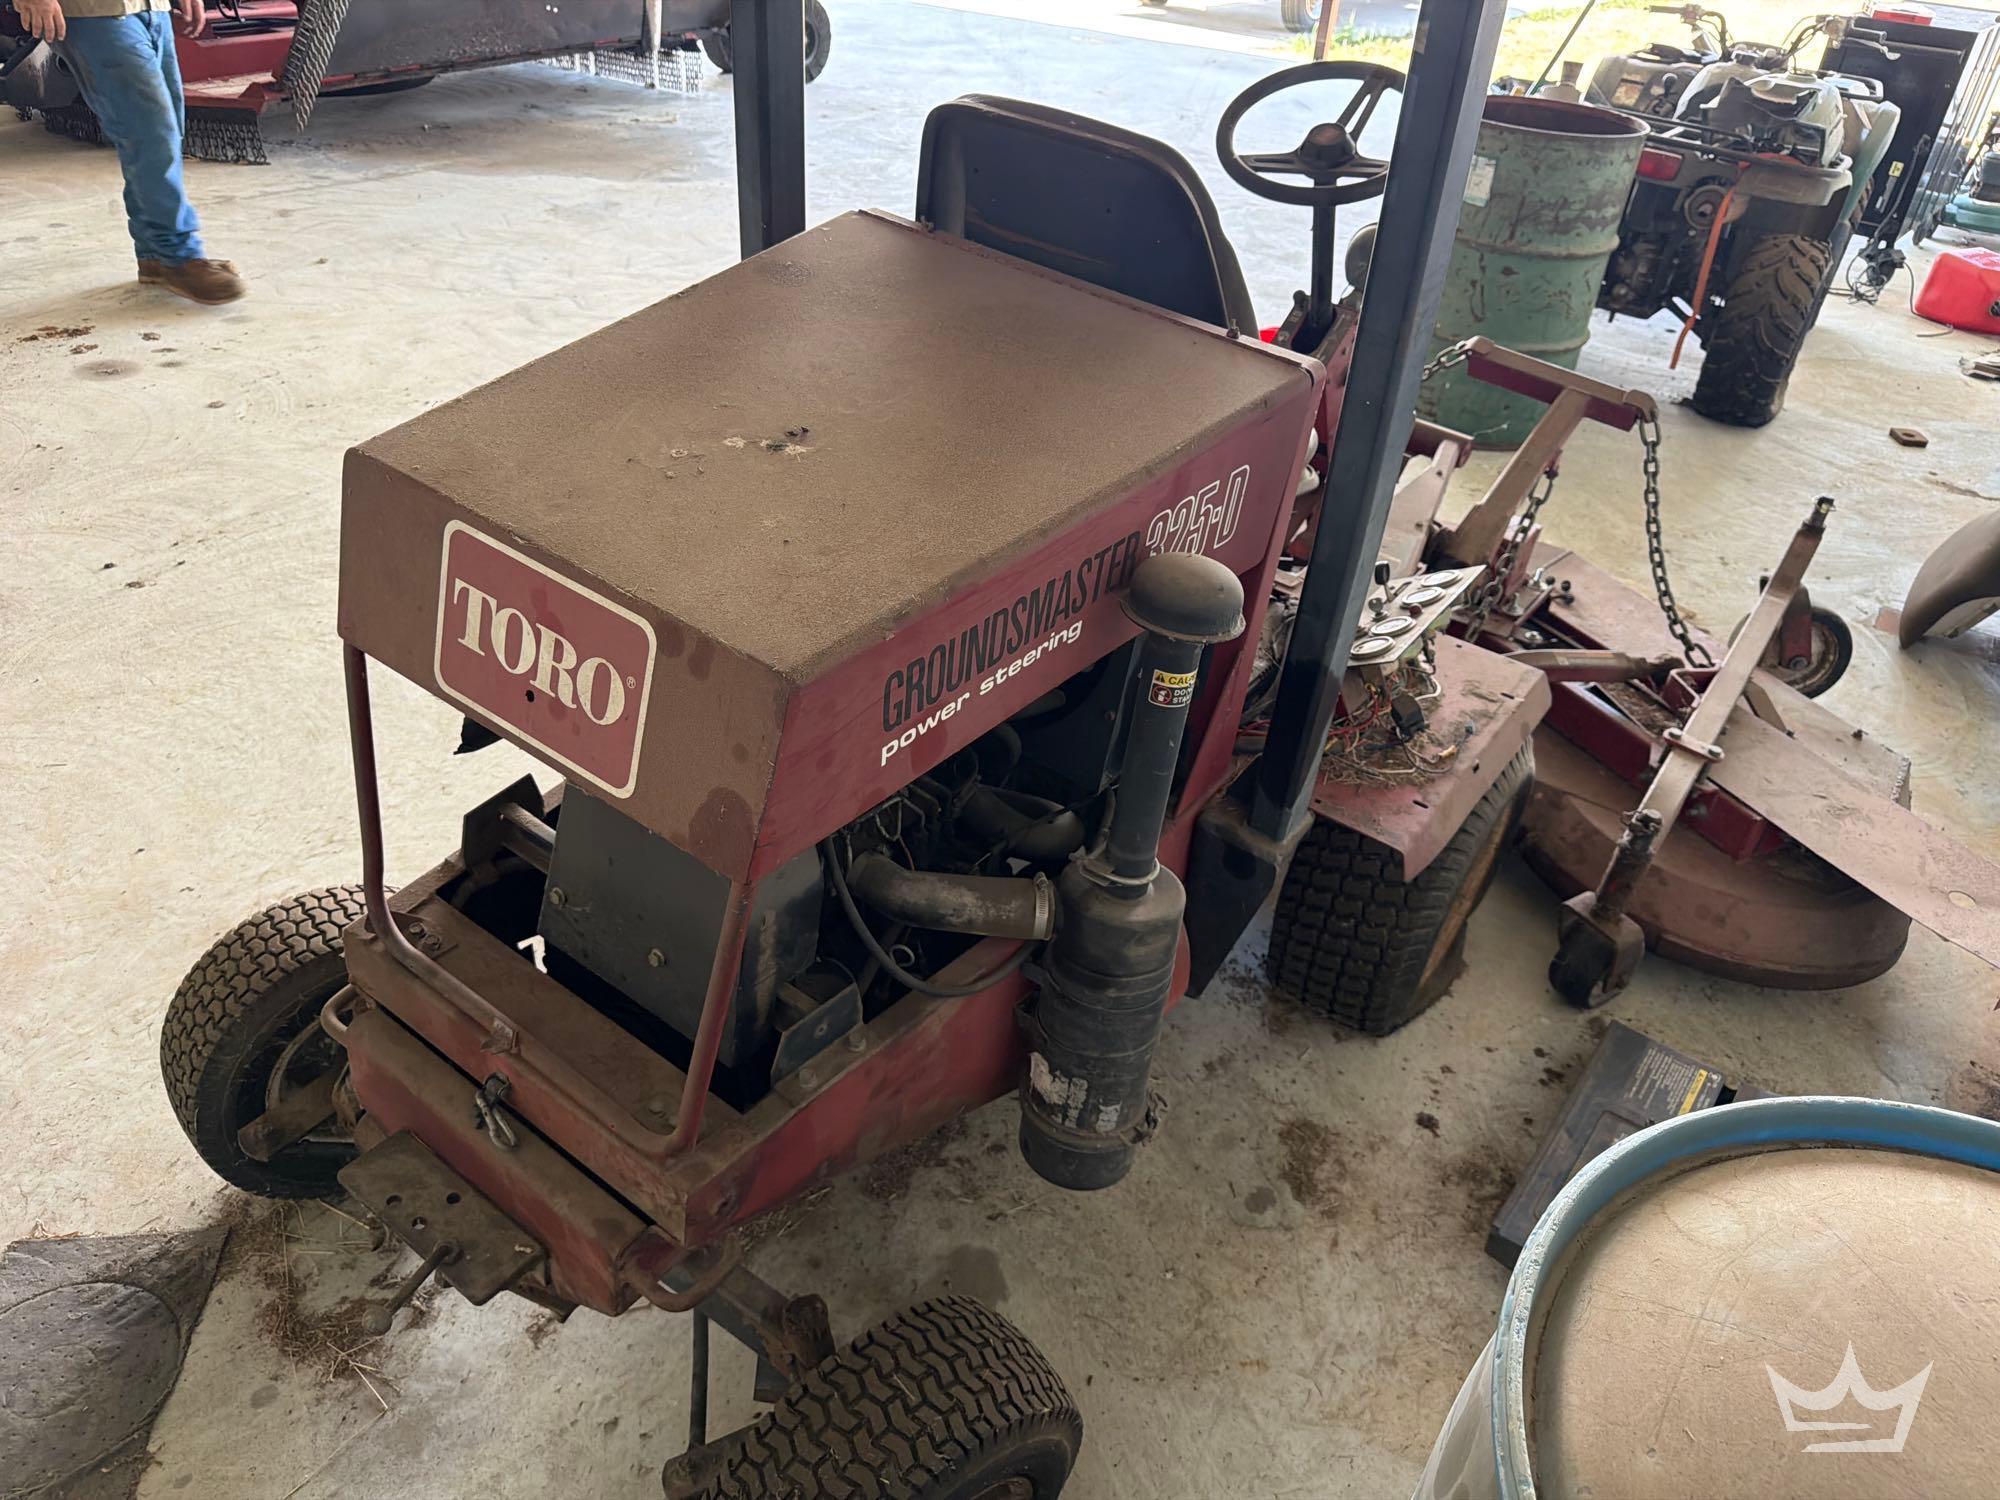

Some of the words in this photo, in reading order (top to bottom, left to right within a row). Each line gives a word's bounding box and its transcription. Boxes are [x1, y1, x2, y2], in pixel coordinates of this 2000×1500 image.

[881, 692, 970, 767] power
[979, 620, 1083, 696] steering
[883, 531, 1140, 732] GROUNDSMASTER
